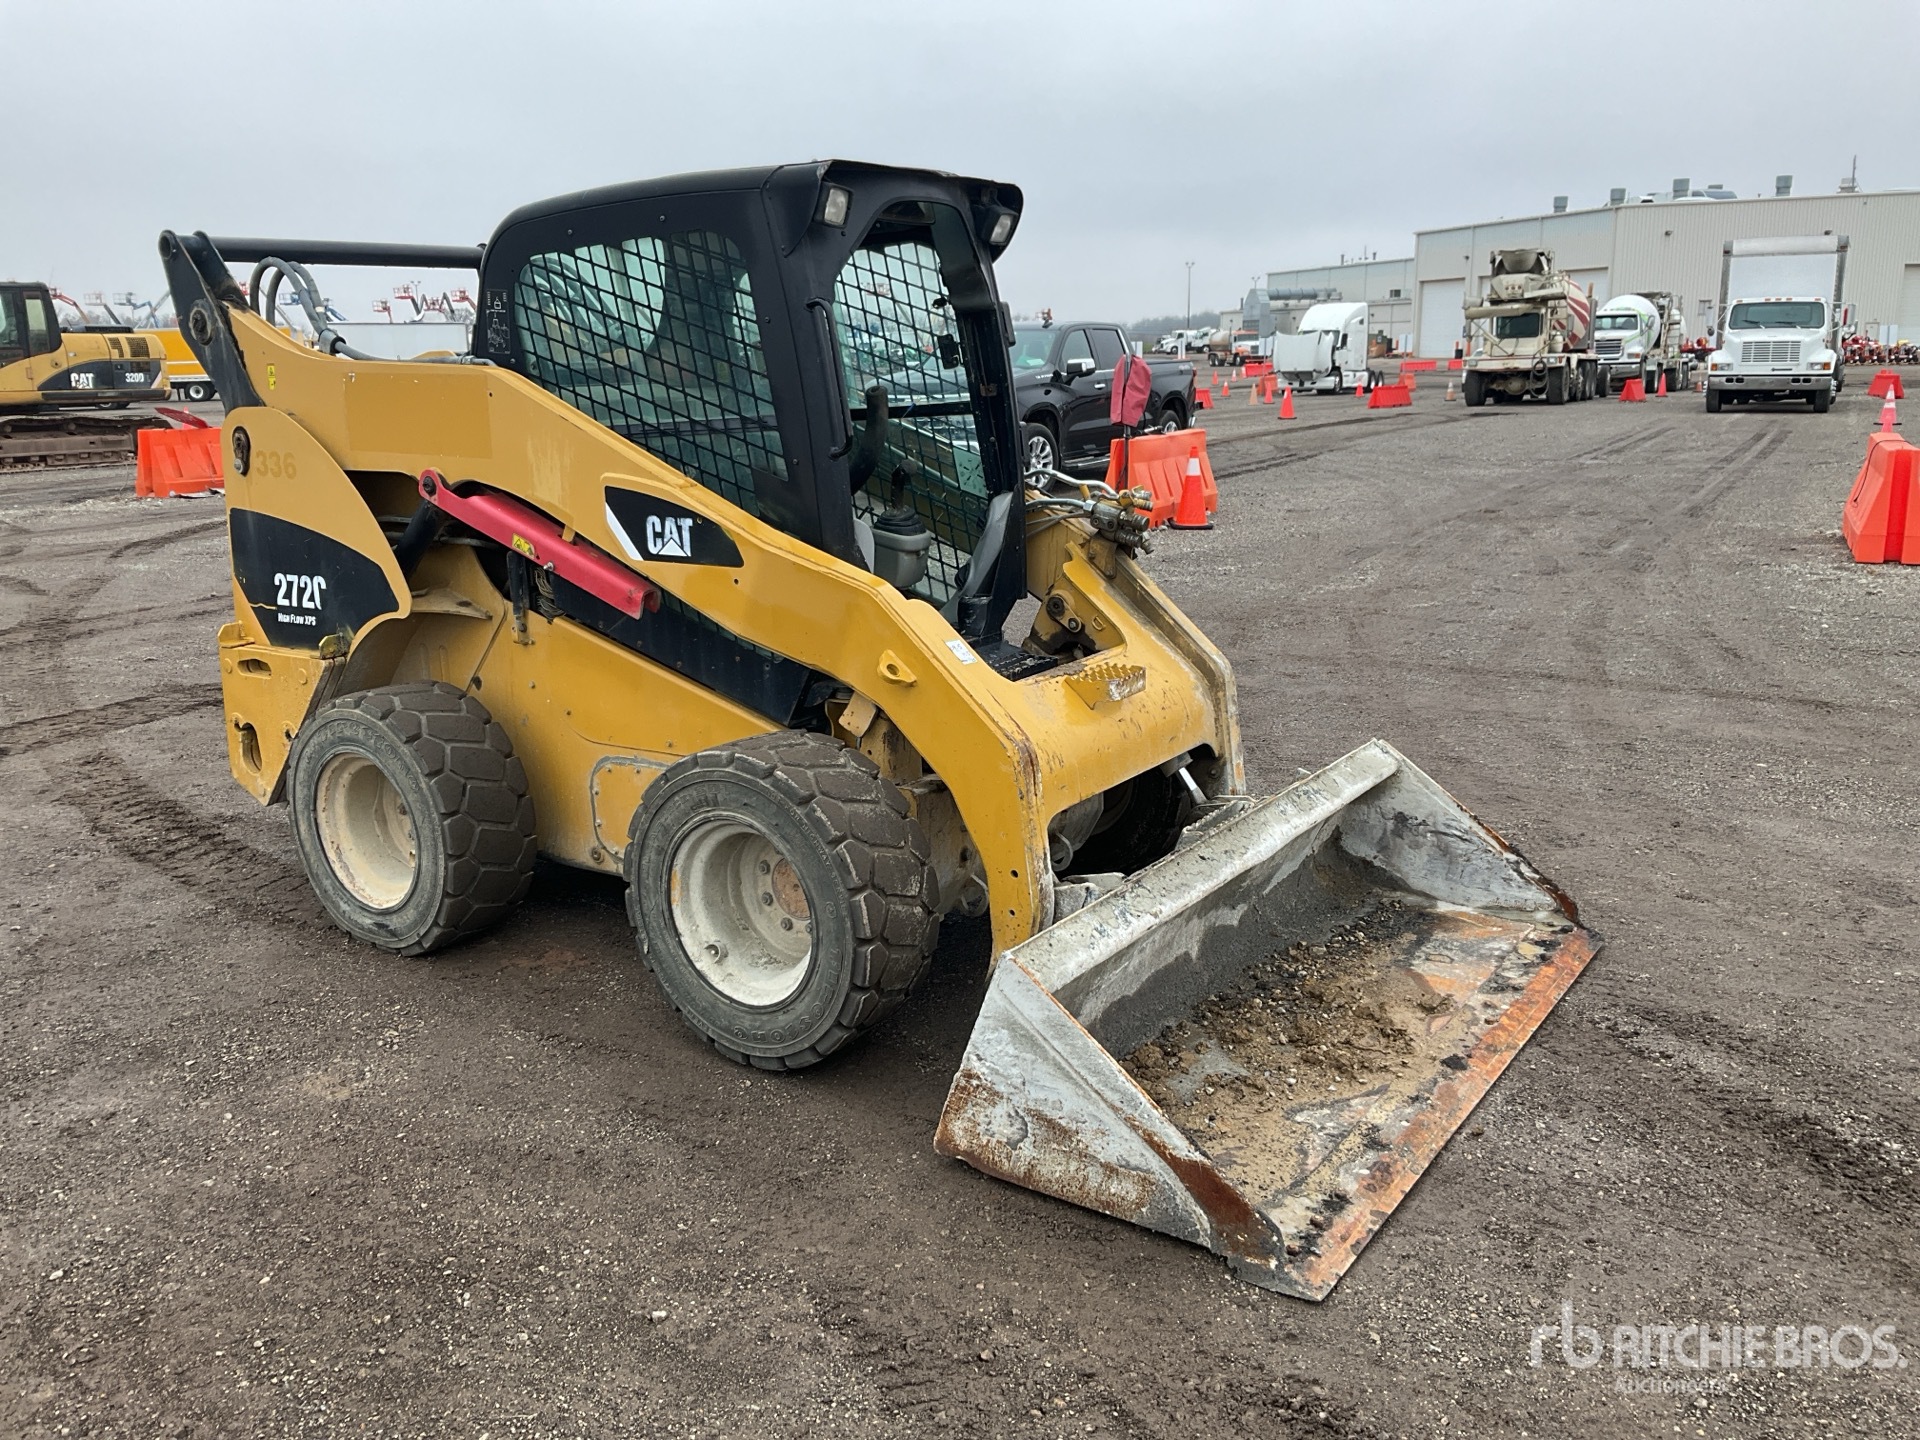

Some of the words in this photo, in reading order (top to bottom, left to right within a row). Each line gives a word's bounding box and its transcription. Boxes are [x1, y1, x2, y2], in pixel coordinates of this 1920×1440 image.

[70, 372, 95, 389] CAT
[255, 449, 297, 480] 336
[646, 515, 693, 557] CAT
[274, 572, 327, 610] 272C
[304, 615, 317, 626] XPS
[801, 823, 832, 865] HIGHWAY
